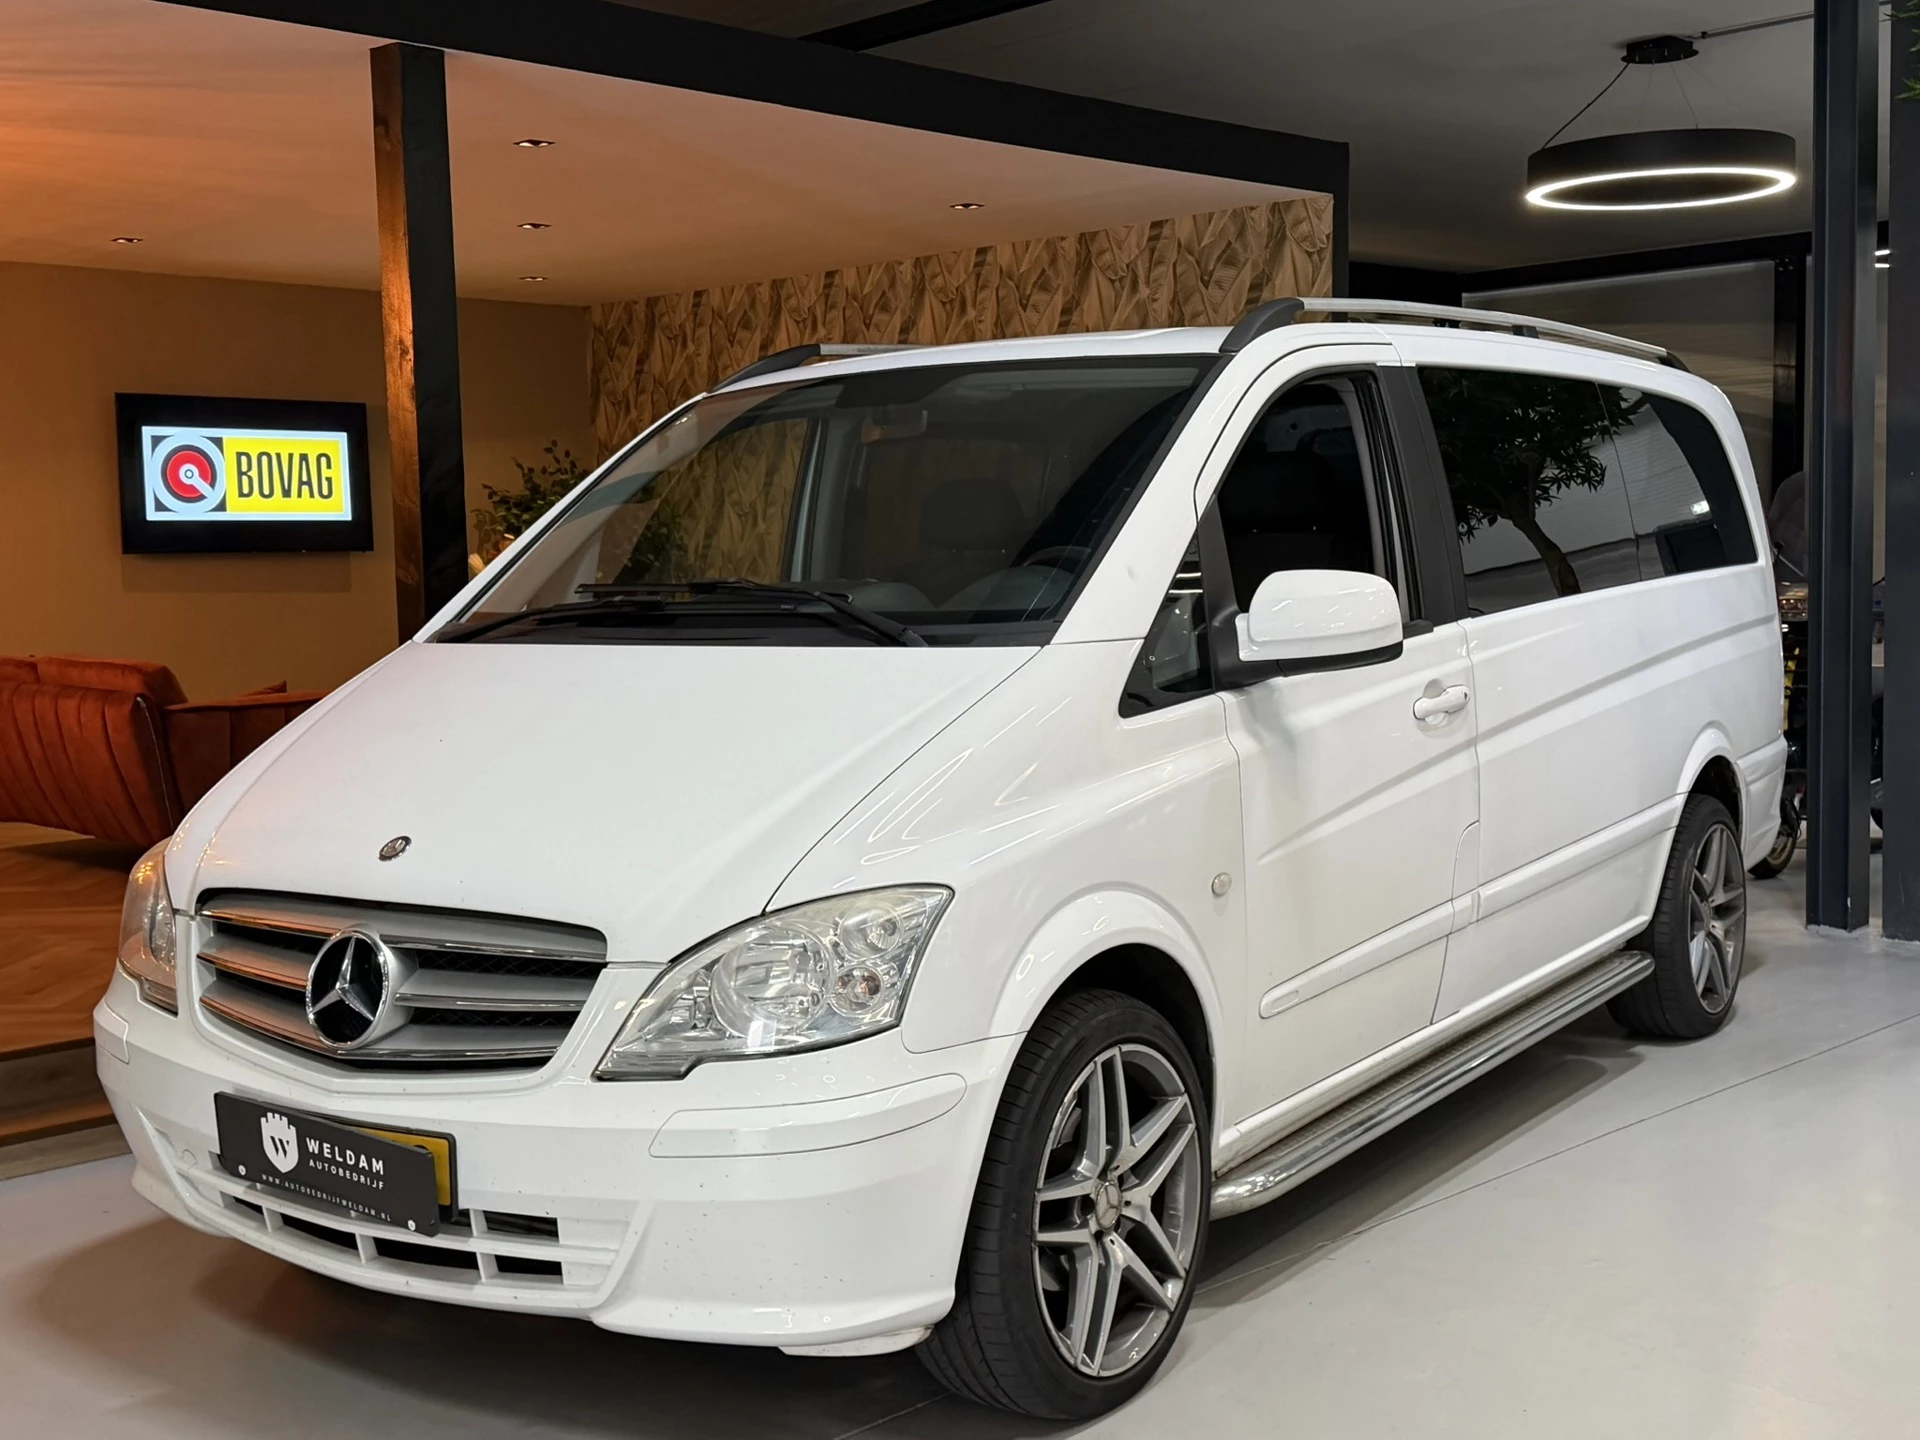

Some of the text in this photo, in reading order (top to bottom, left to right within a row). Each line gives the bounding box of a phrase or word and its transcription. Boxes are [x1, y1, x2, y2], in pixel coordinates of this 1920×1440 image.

[235, 451, 334, 500] BOVAG
[270, 1135, 290, 1159] W
[306, 1137, 384, 1175] WELDAM
[309, 1159, 384, 1190] AUTOBEDRIJF
[262, 1174, 391, 1221] WWW.AUTOBEDRIJFWELDAM.NL
